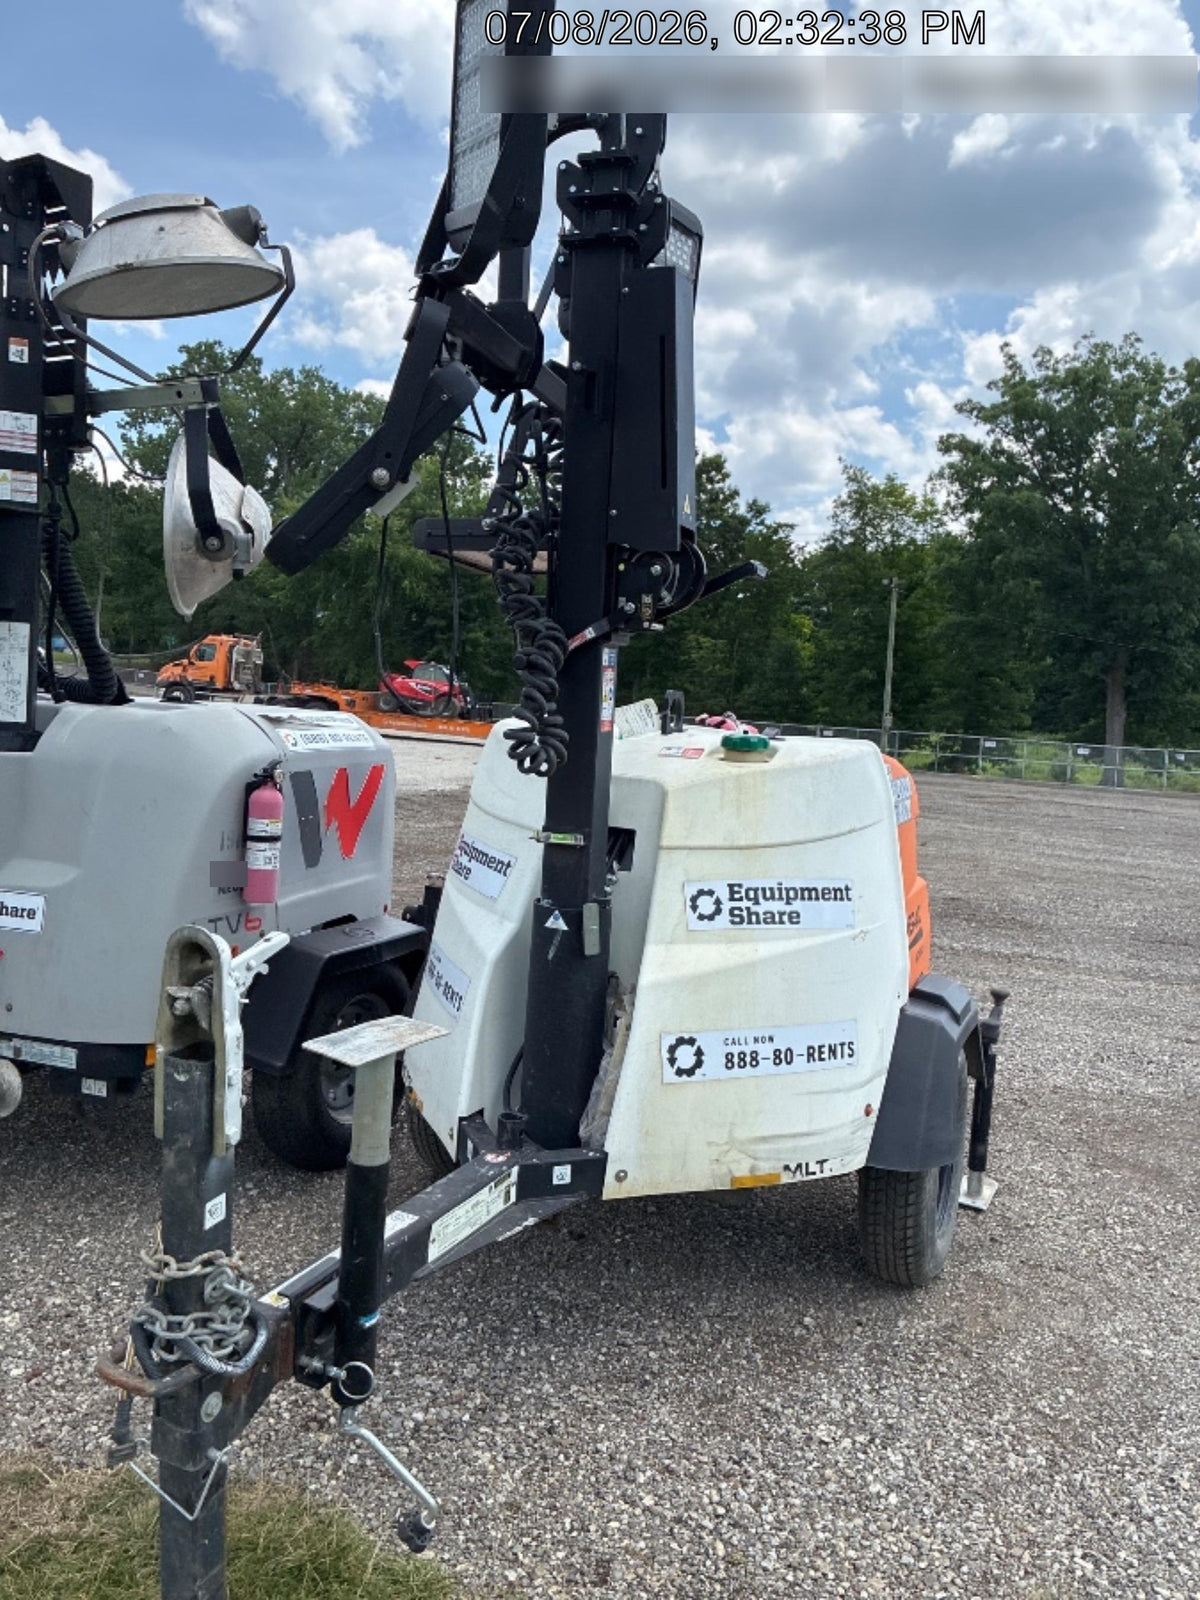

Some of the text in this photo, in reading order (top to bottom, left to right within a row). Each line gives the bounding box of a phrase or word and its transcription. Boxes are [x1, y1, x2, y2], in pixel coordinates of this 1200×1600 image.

[726, 882, 853, 906] Equipment
[728, 906, 801, 926] Share
[723, 1035, 775, 1046] CALL NOW
[724, 1041, 855, 1071] 888-80-RENTS
